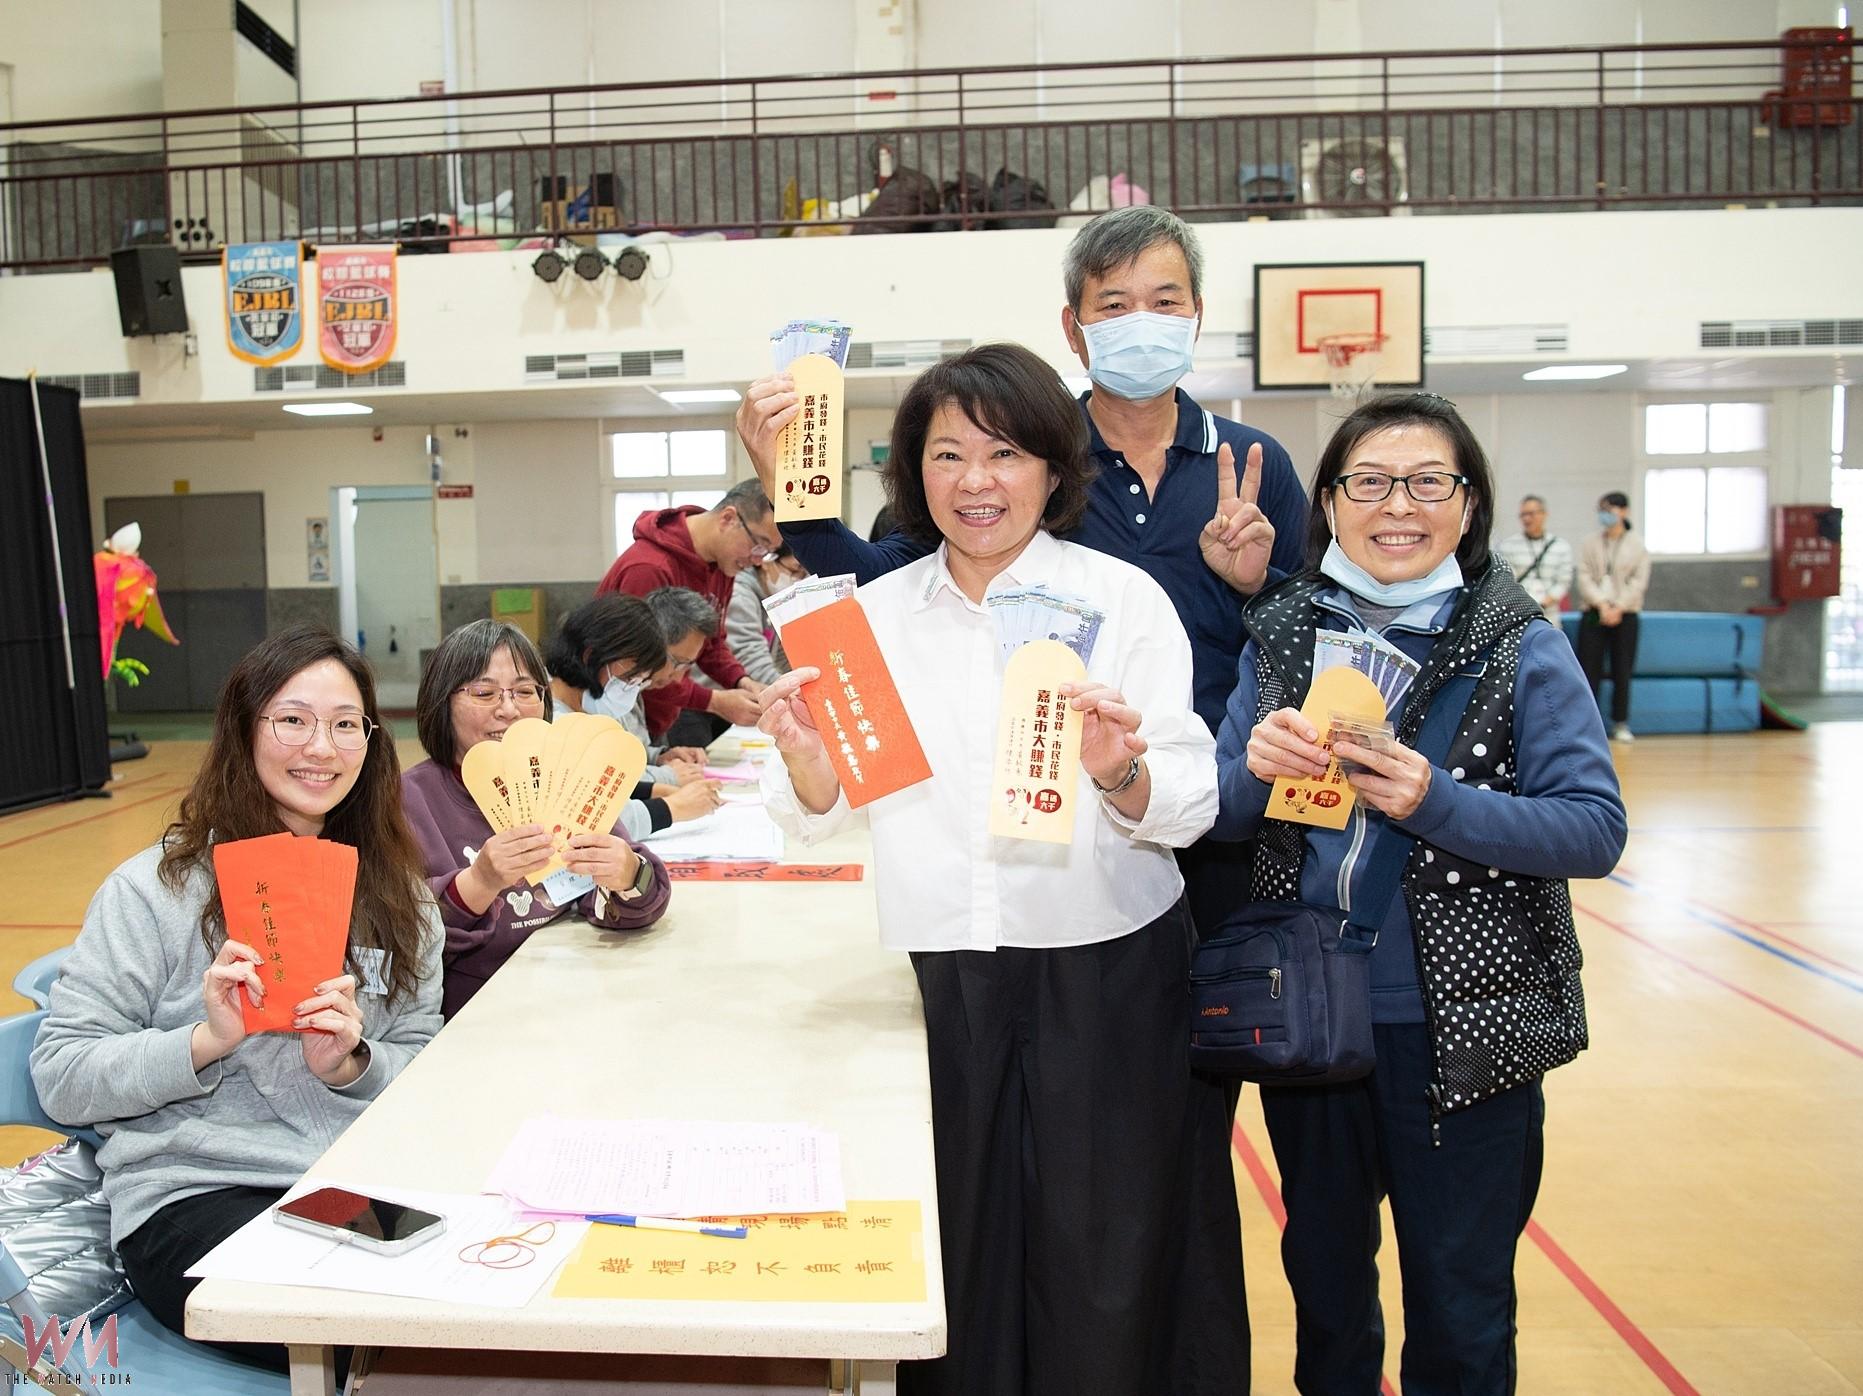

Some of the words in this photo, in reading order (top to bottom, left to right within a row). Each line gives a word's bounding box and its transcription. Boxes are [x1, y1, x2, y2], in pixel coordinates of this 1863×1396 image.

[233, 290, 296, 312] EJBL
[325, 301, 389, 321] EJBL
[802, 395, 816, 469] 嘉義市大賺錢
[1029, 689, 1051, 779] 嘉義市大賺錢
[576, 764, 617, 826] 嘉義市大賺錢
[599, 1257, 893, 1276] 離櫃恕不負責
